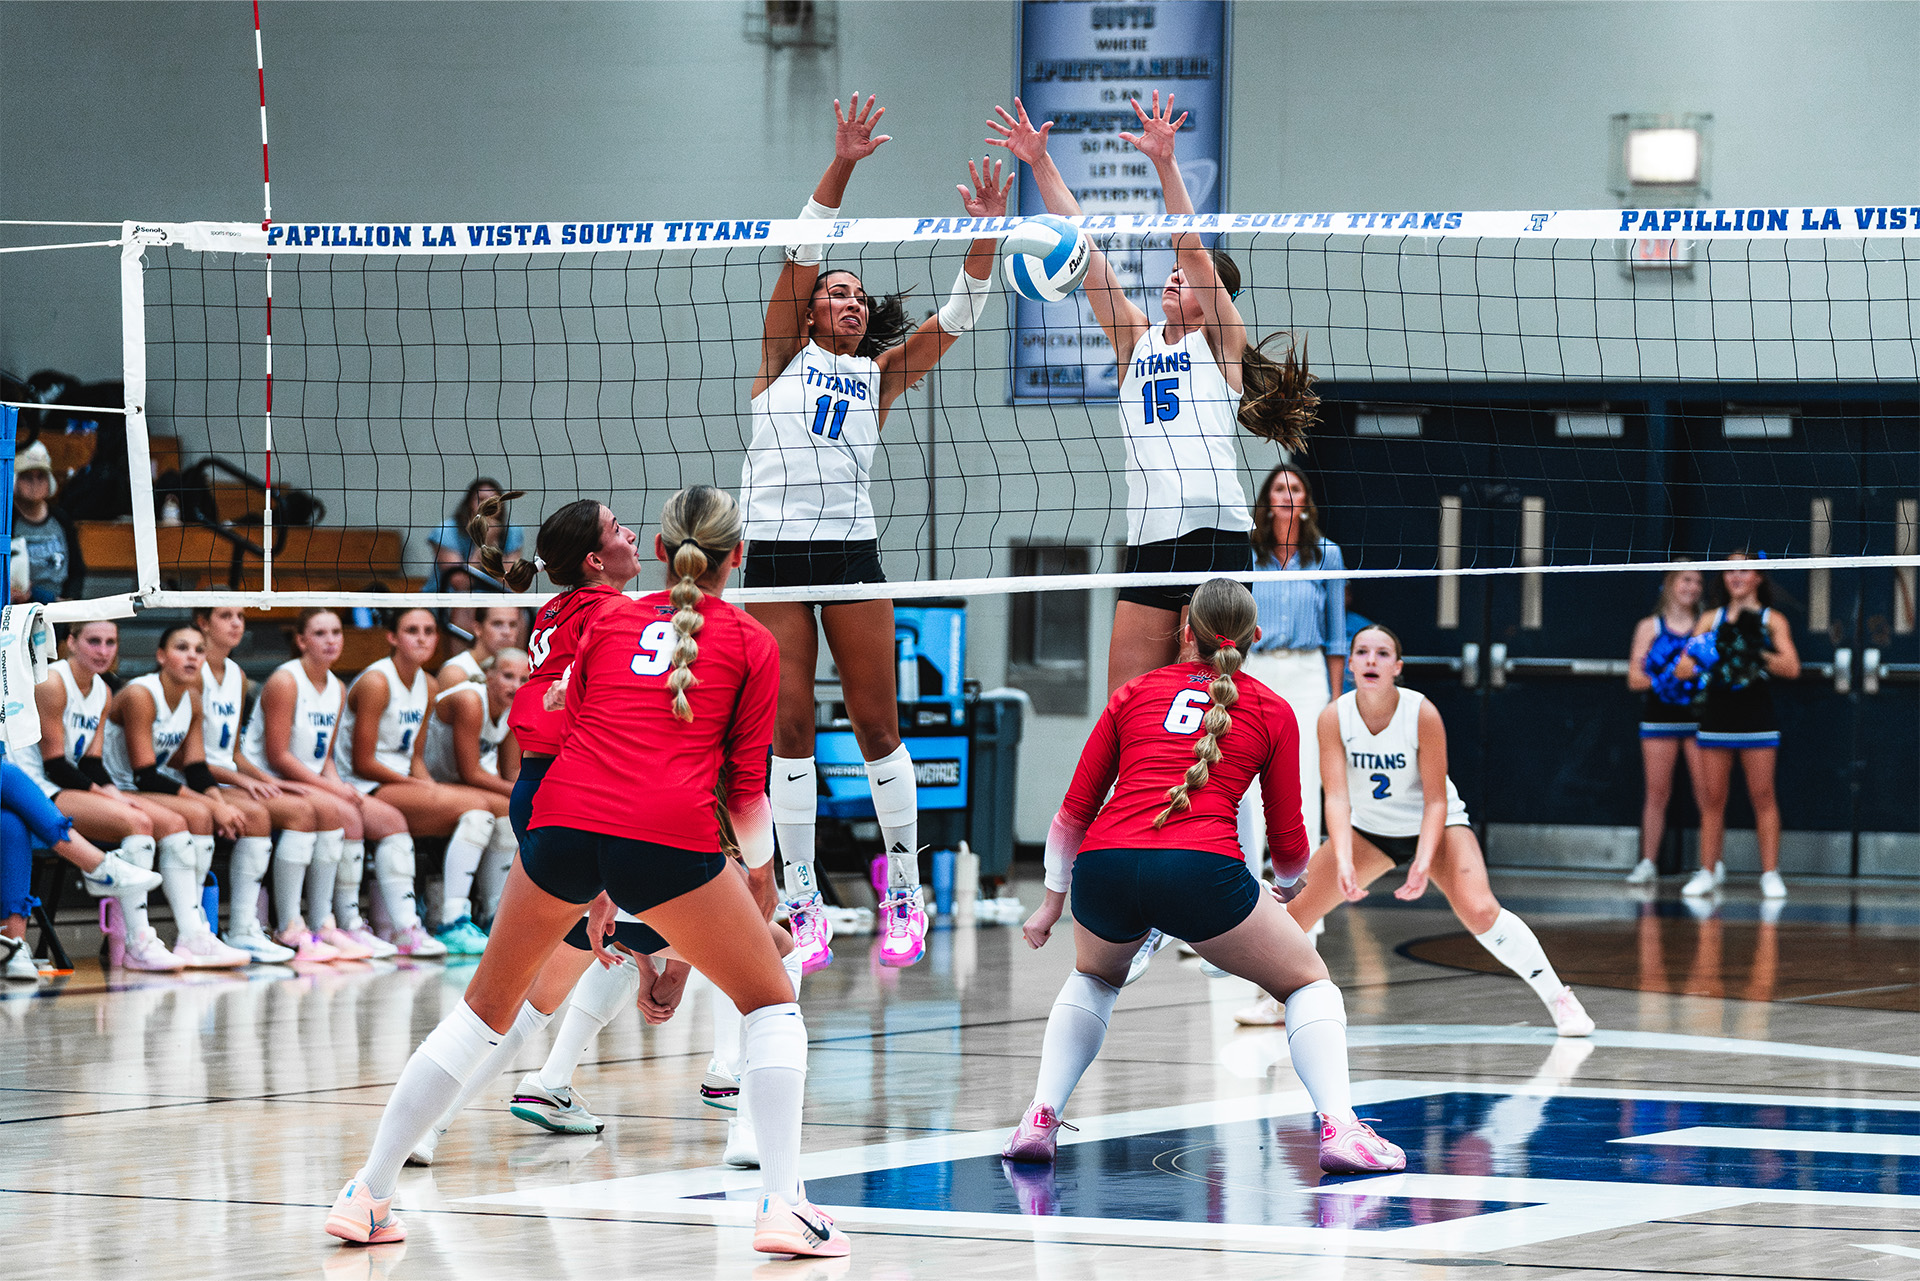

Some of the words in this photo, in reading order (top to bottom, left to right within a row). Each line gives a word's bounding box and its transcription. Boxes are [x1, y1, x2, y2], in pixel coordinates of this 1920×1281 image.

[266, 225, 412, 247] PAPILLION
[422, 225, 457, 247] LA
[467, 224, 552, 246] VISTA
[561, 222, 654, 245] SOUTH
[664, 220, 771, 243] TITANS
[913, 216, 1027, 235] PAPILL
[1079, 215, 1116, 229] LA
[1131, 213, 1220, 228] VISTA
[1231, 212, 1331, 228] SOUTH
[1347, 212, 1463, 230] TITANS
[1619, 209, 1789, 232] PAPILLION
[1801, 208, 1842, 231] LA
[806, 365, 868, 401] TITANS
[1142, 377, 1180, 425] 15
[811, 394, 850, 441] 11
[630, 620, 679, 677] 9
[1163, 687, 1211, 735] 6
[1351, 752, 1407, 770] TITANS
[1370, 773, 1392, 800] 2
